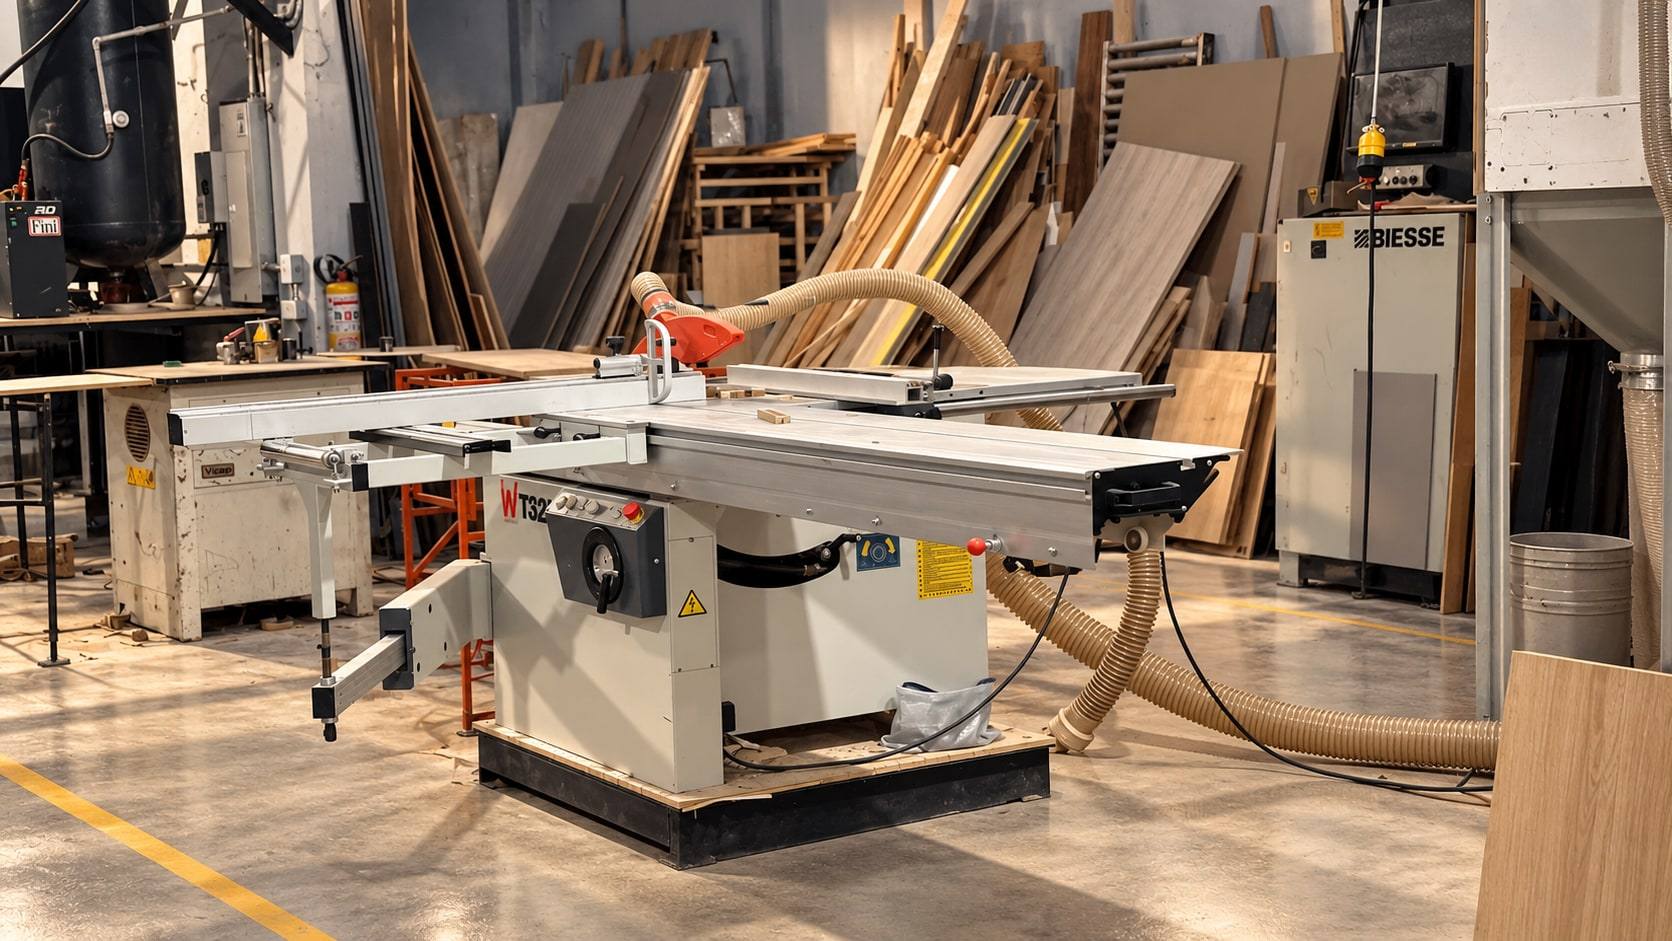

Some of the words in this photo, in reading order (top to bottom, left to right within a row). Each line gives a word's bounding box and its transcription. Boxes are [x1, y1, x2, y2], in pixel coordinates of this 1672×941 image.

[32, 219, 57, 233] Fini
[1371, 226, 1446, 248] BIESSE
[500, 479, 552, 524] WT32
